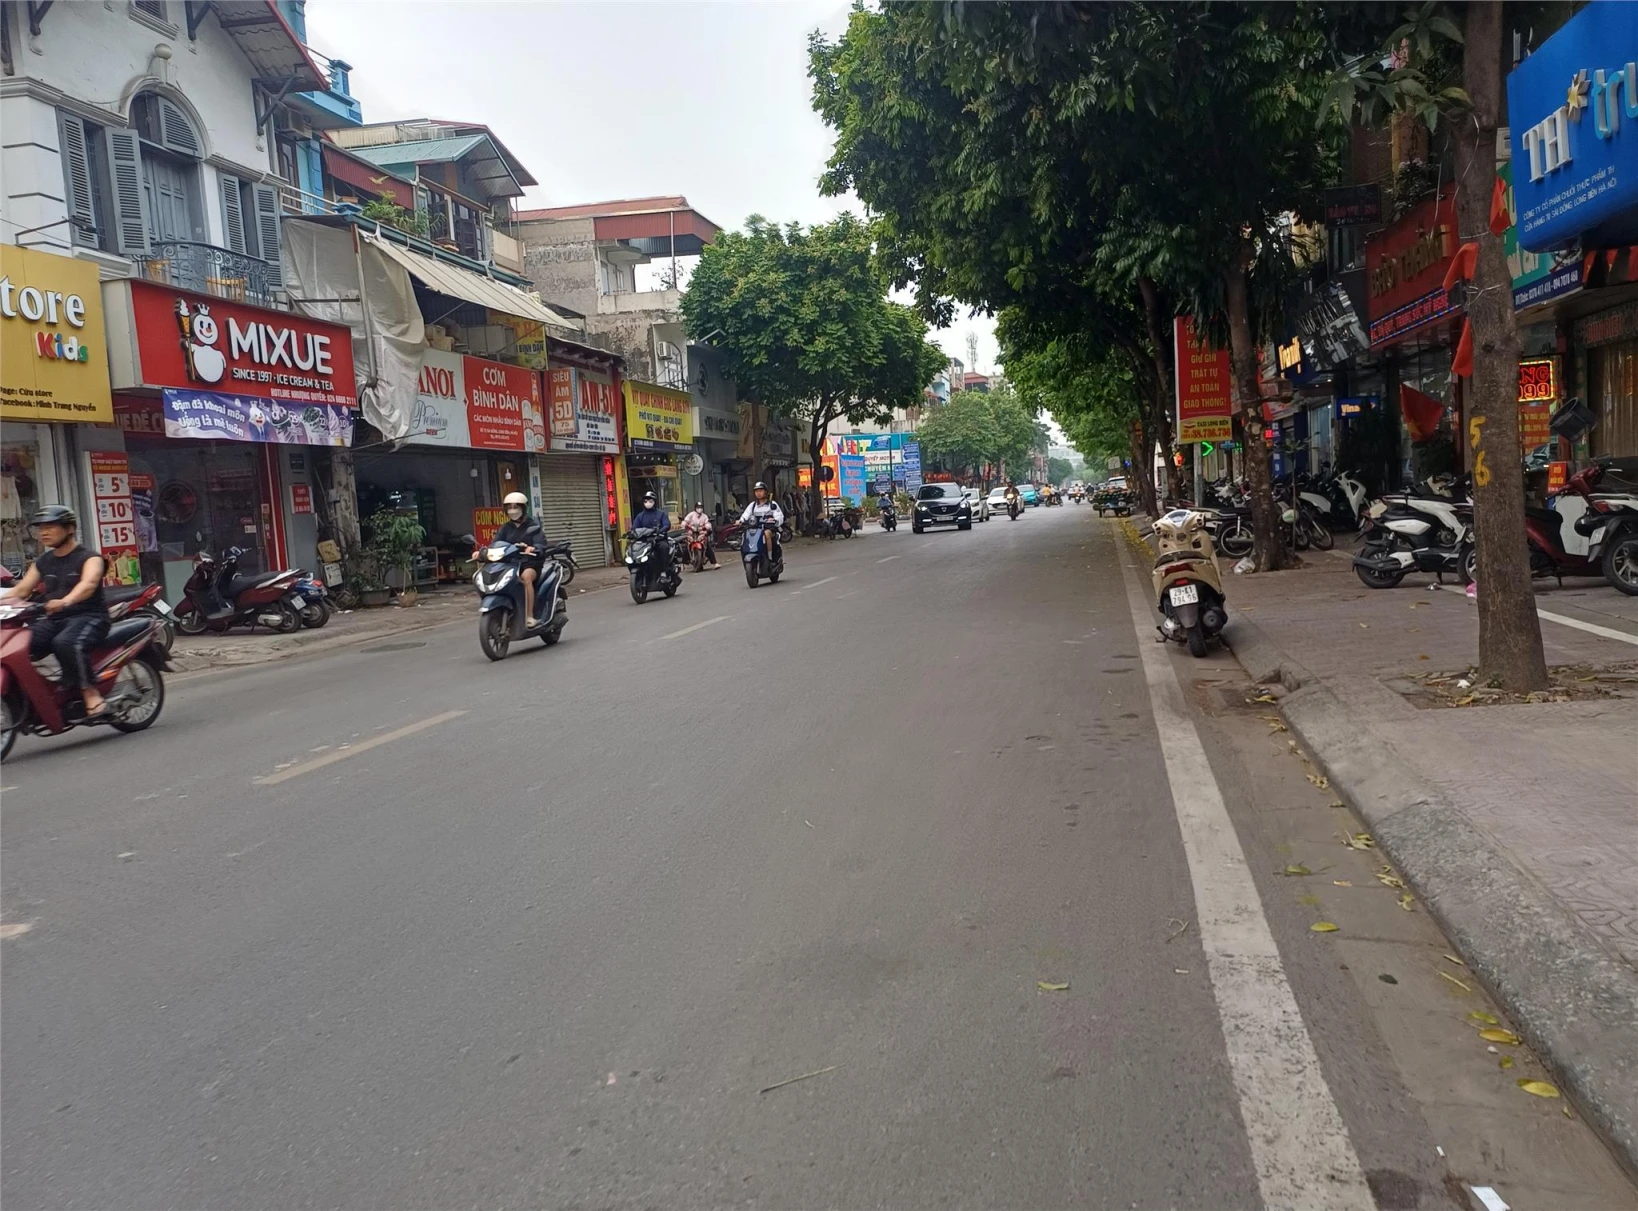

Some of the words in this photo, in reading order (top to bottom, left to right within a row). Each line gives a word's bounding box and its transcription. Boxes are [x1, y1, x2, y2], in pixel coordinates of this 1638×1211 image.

[1522, 106, 1573, 182] TH
[1524, 209, 1534, 220] CÔNG
[1536, 206, 1541, 214] TY
[1608, 166, 1614, 174] TH
[1574, 194, 1587, 206] LONG
[1588, 187, 1597, 200] BIÊN
[1599, 182, 1606, 193] HÀ
[36, 331, 88, 362] Kids
[228, 317, 333, 374] MIXUE
[1191, 354, 1203, 363] GIỮ
[233, 368, 255, 380] SINCE
[258, 371, 272, 382] 1997
[277, 373, 289, 384] ICE
[290, 376, 313, 388] CREAM
[315, 380, 320, 388] &
[321, 381, 334, 391] TEA
[483, 367, 506, 387] CƠM
[553, 371, 569, 382] SIÊU
[1191, 368, 1207, 378] TRẬT
[1210, 368, 1218, 379] TỰ
[1520, 366, 1549, 383] NG
[0, 386, 17, 396] age:
[556, 385, 569, 397] ÂM
[1190, 384, 1199, 393] AN
[1202, 383, 1219, 392] TOÀN
[473, 386, 497, 408] BÌNH
[499, 390, 519, 411] DÂN
[1184, 399, 1199, 408] GIAO
[54, 402, 72, 411] Trang
[204, 400, 225, 414] khoai
[555, 401, 572, 419] 5D
[201, 414, 212, 425] là
[476, 510, 492, 524] CƠM
